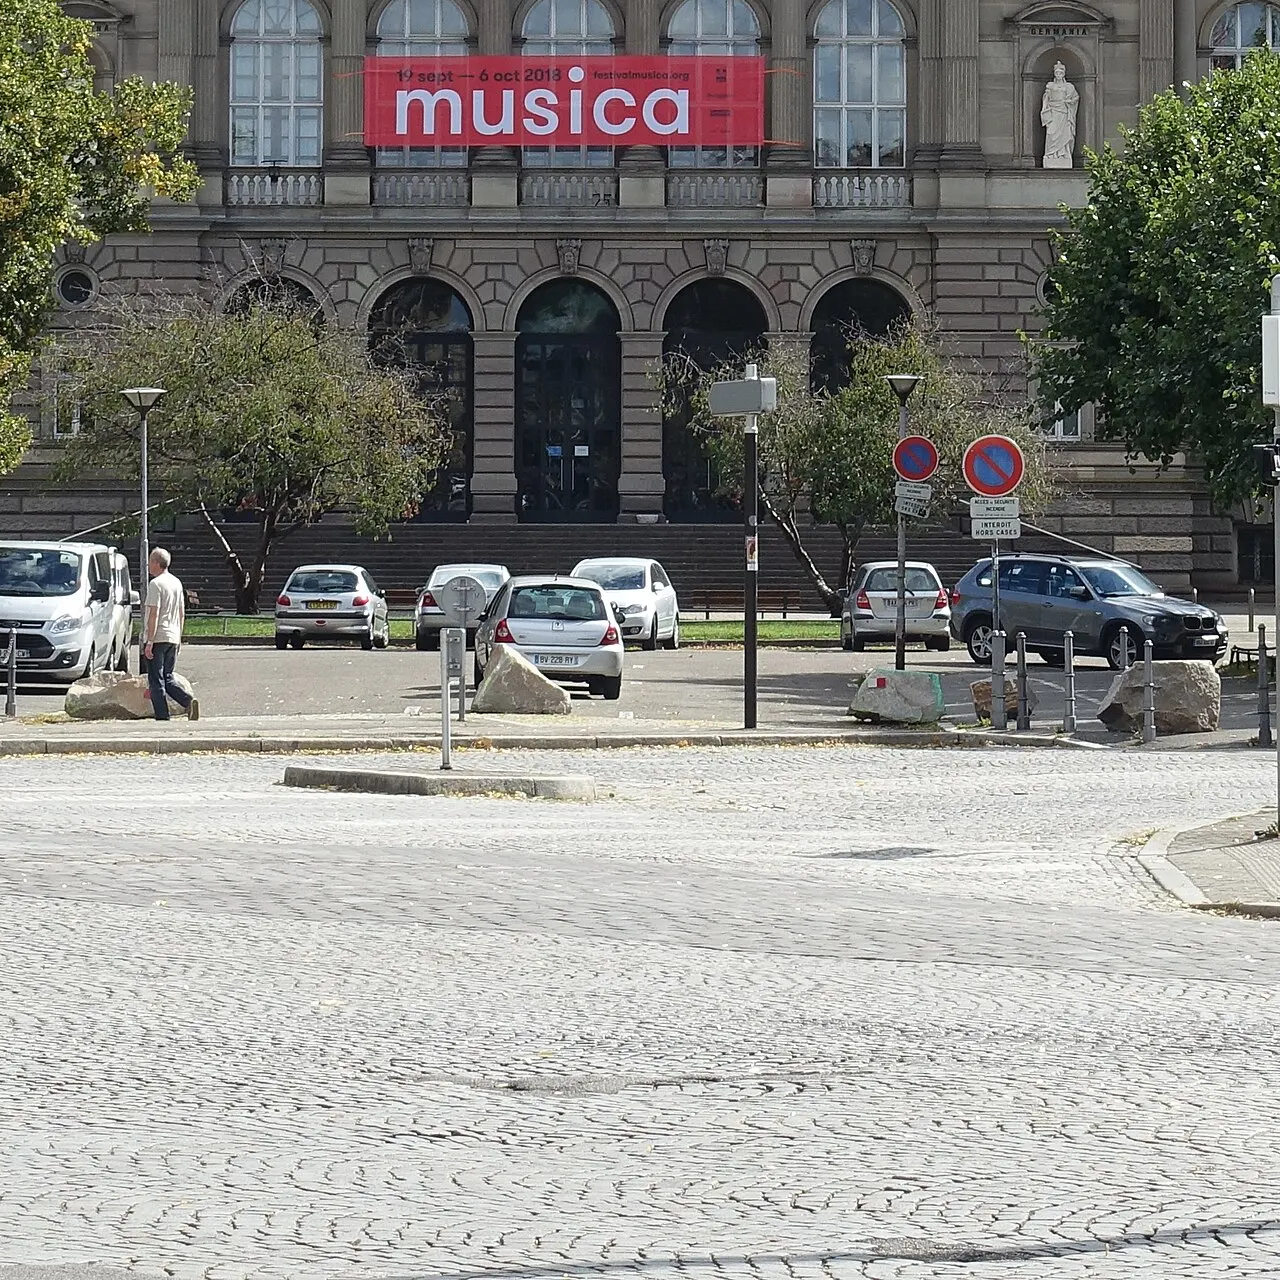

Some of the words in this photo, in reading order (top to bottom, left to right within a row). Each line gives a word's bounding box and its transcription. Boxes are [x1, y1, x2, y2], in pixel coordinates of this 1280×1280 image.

[1030, 27, 1088, 36] GERMANIA
[397, 69, 413, 83] 19
[417, 70, 454, 85] sept
[479, 68, 490, 83] 6
[493, 70, 520, 83] oct
[524, 69, 562, 83] 2018
[593, 70, 690, 82] festivalmusica.org
[395, 66, 690, 136] musica
